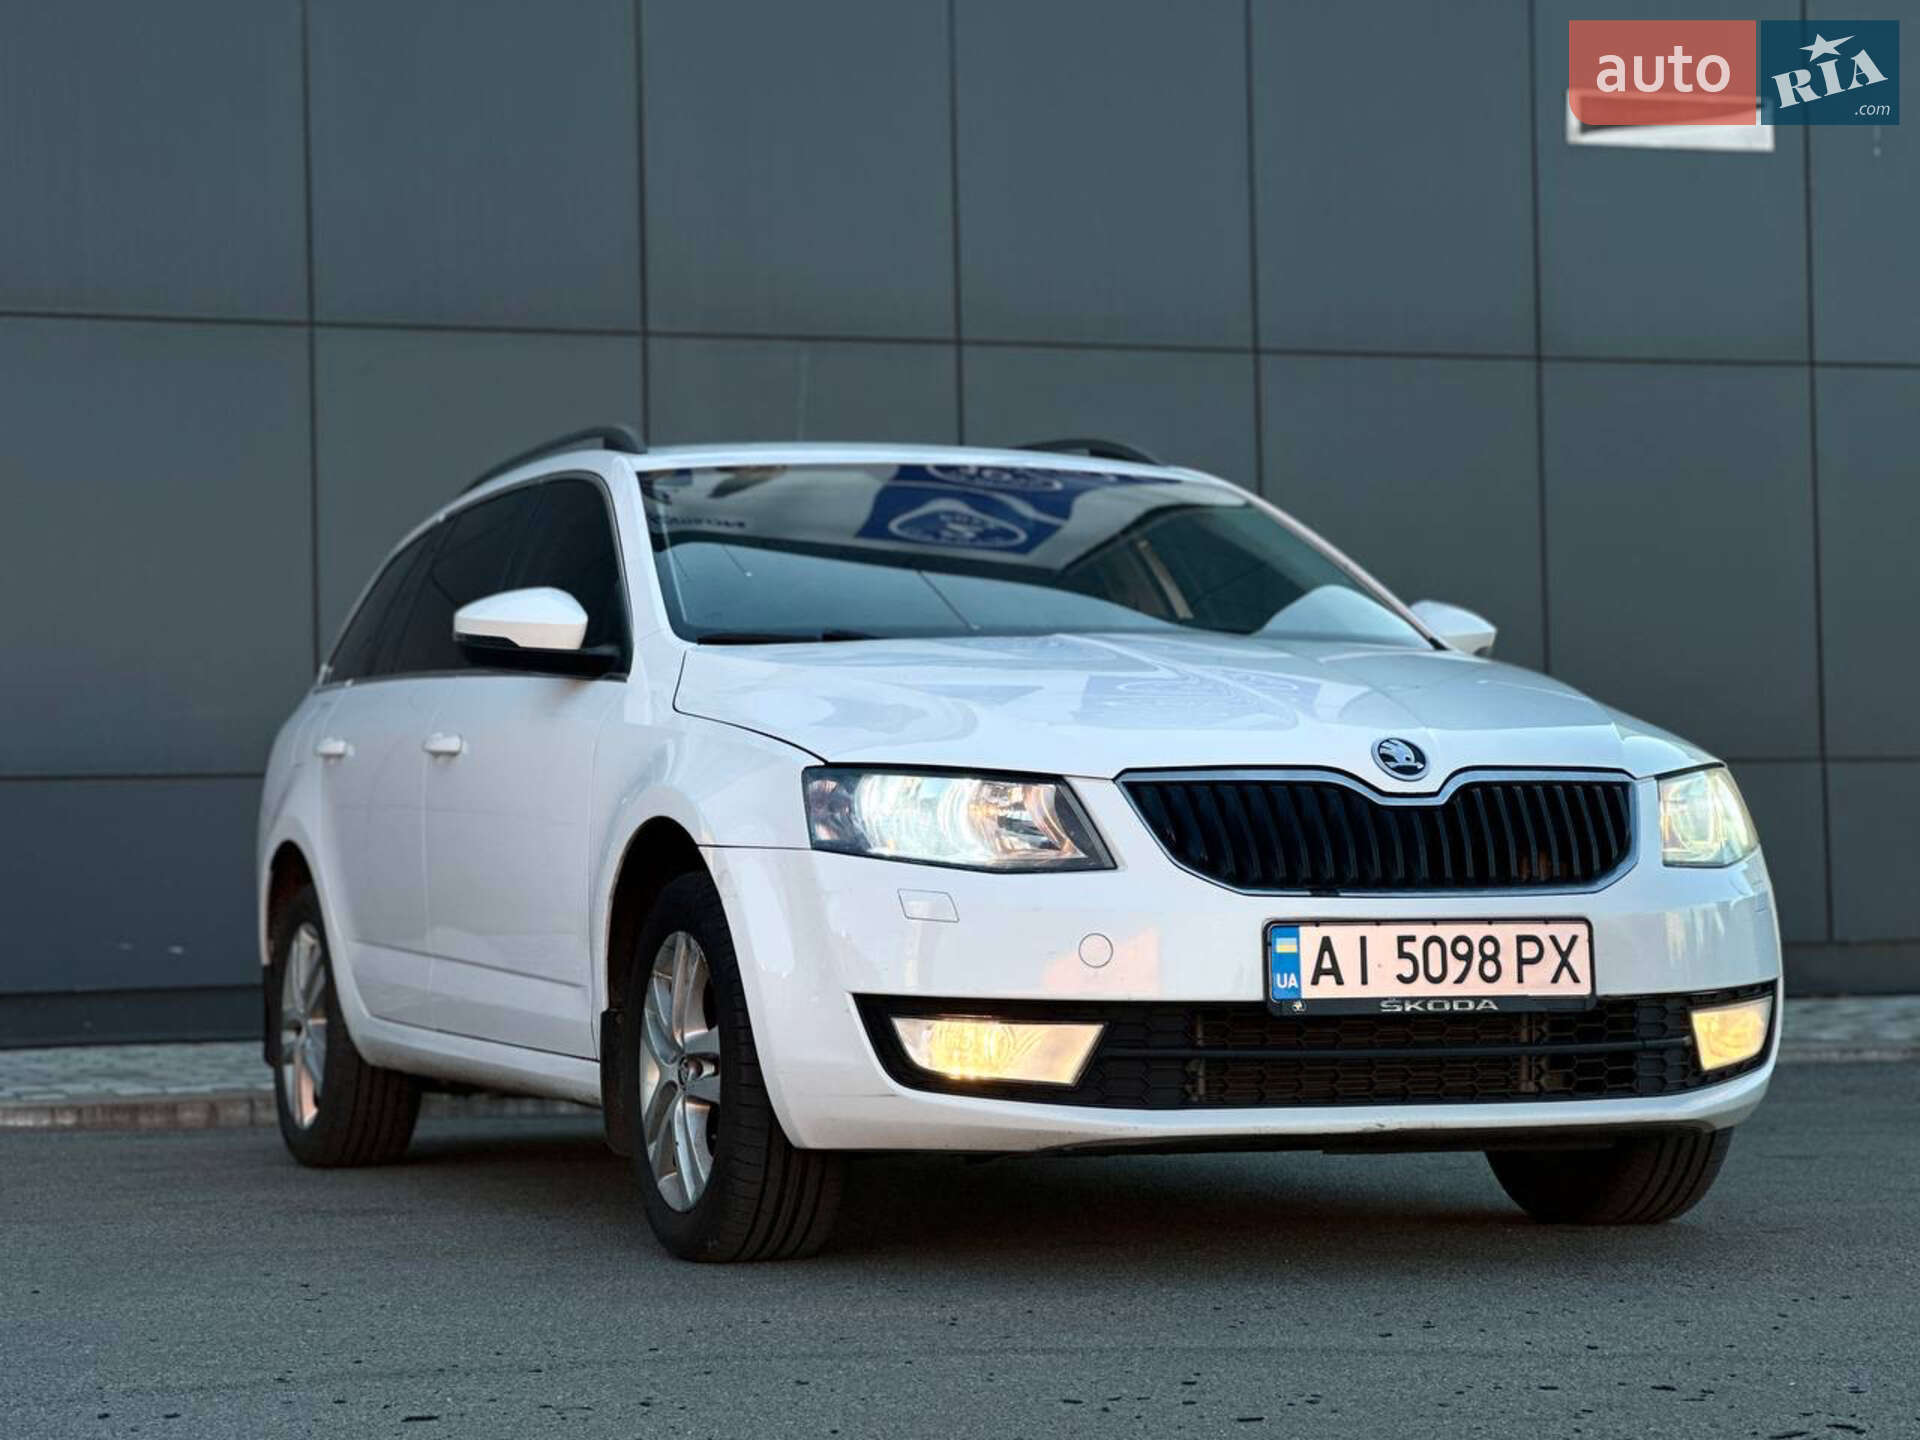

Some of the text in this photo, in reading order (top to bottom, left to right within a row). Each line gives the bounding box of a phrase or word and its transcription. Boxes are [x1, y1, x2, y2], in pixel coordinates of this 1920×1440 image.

[1310, 934, 1581, 986] AI 5098 PX
[1276, 972, 1299, 989] UA
